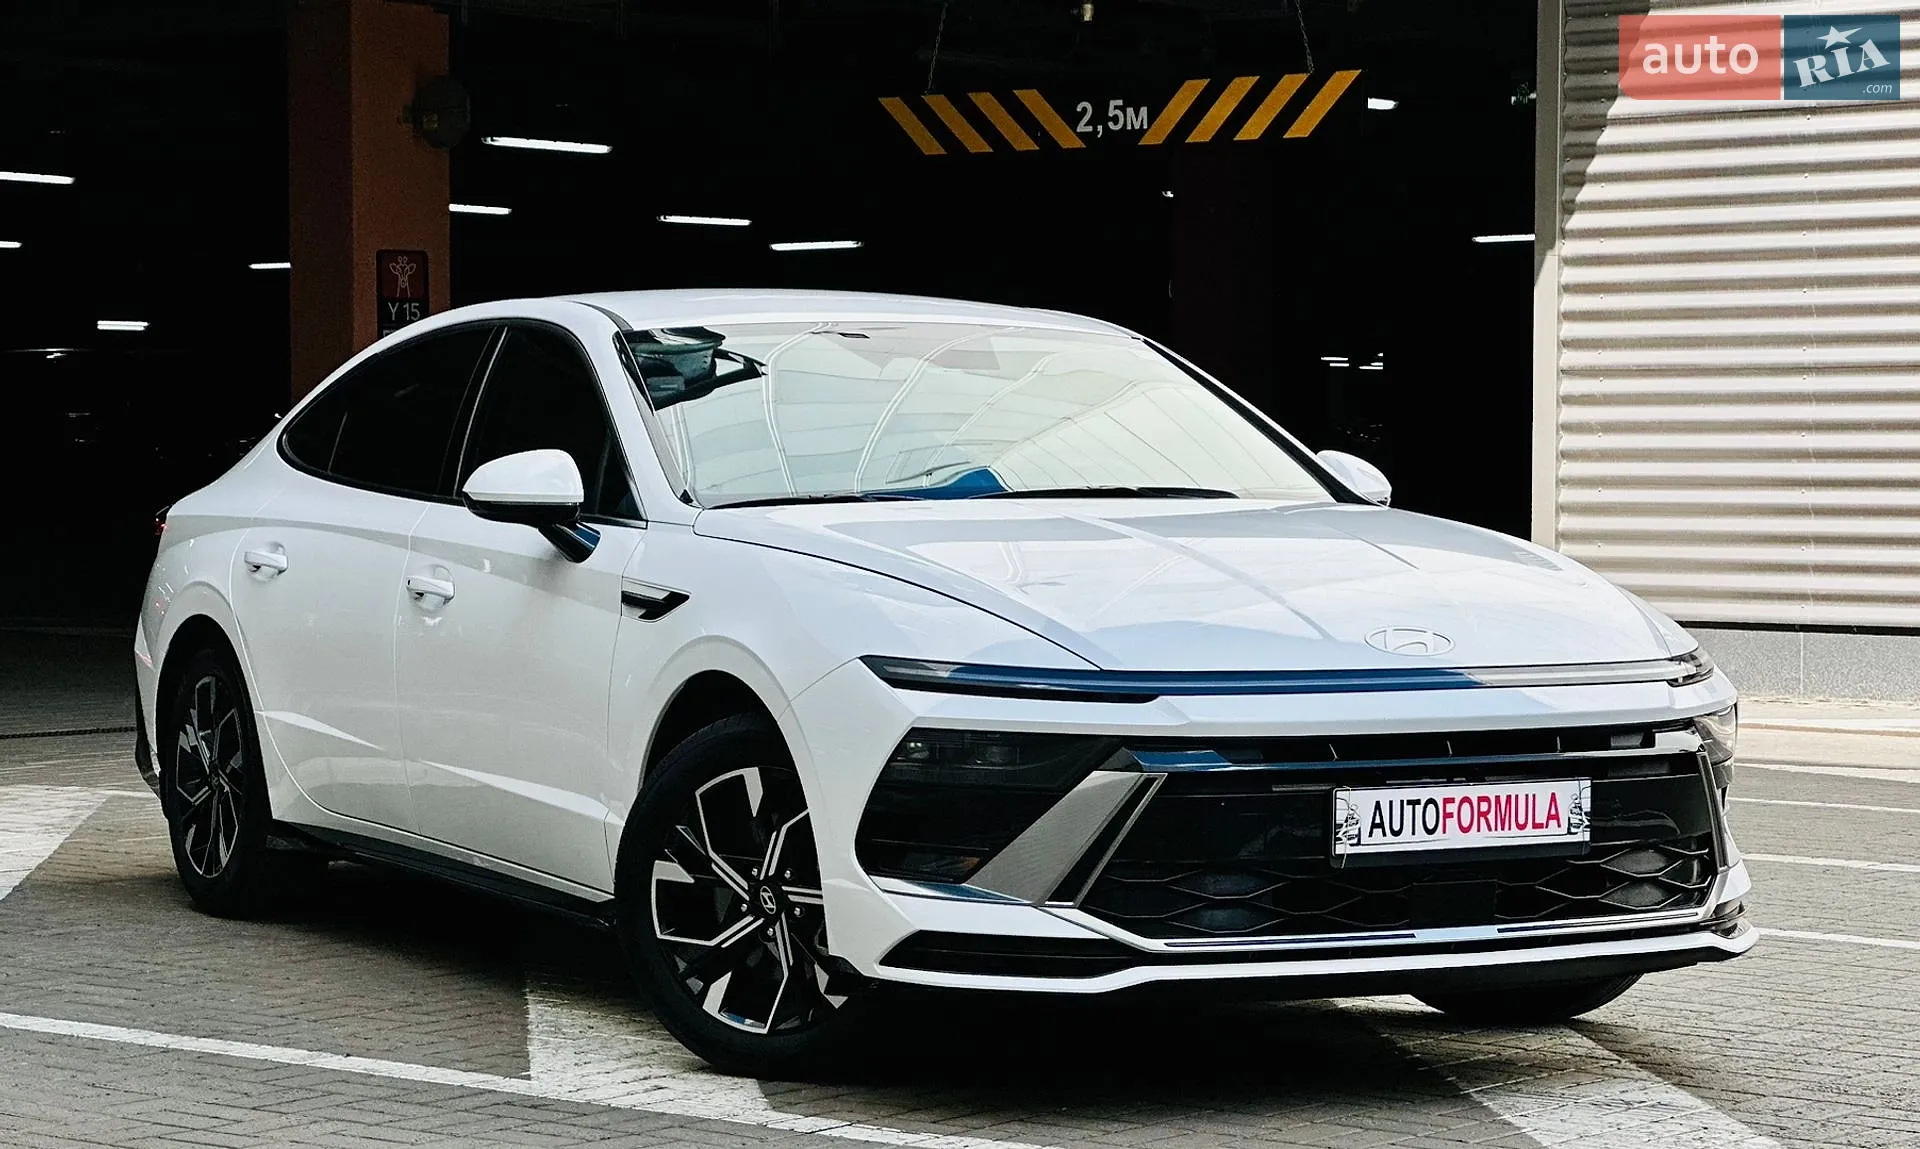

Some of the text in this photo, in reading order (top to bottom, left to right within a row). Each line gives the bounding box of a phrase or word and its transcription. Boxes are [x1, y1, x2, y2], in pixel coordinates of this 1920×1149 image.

[387, 301, 421, 321] Y 15
[1368, 792, 1562, 838] AUTOFORMULA
